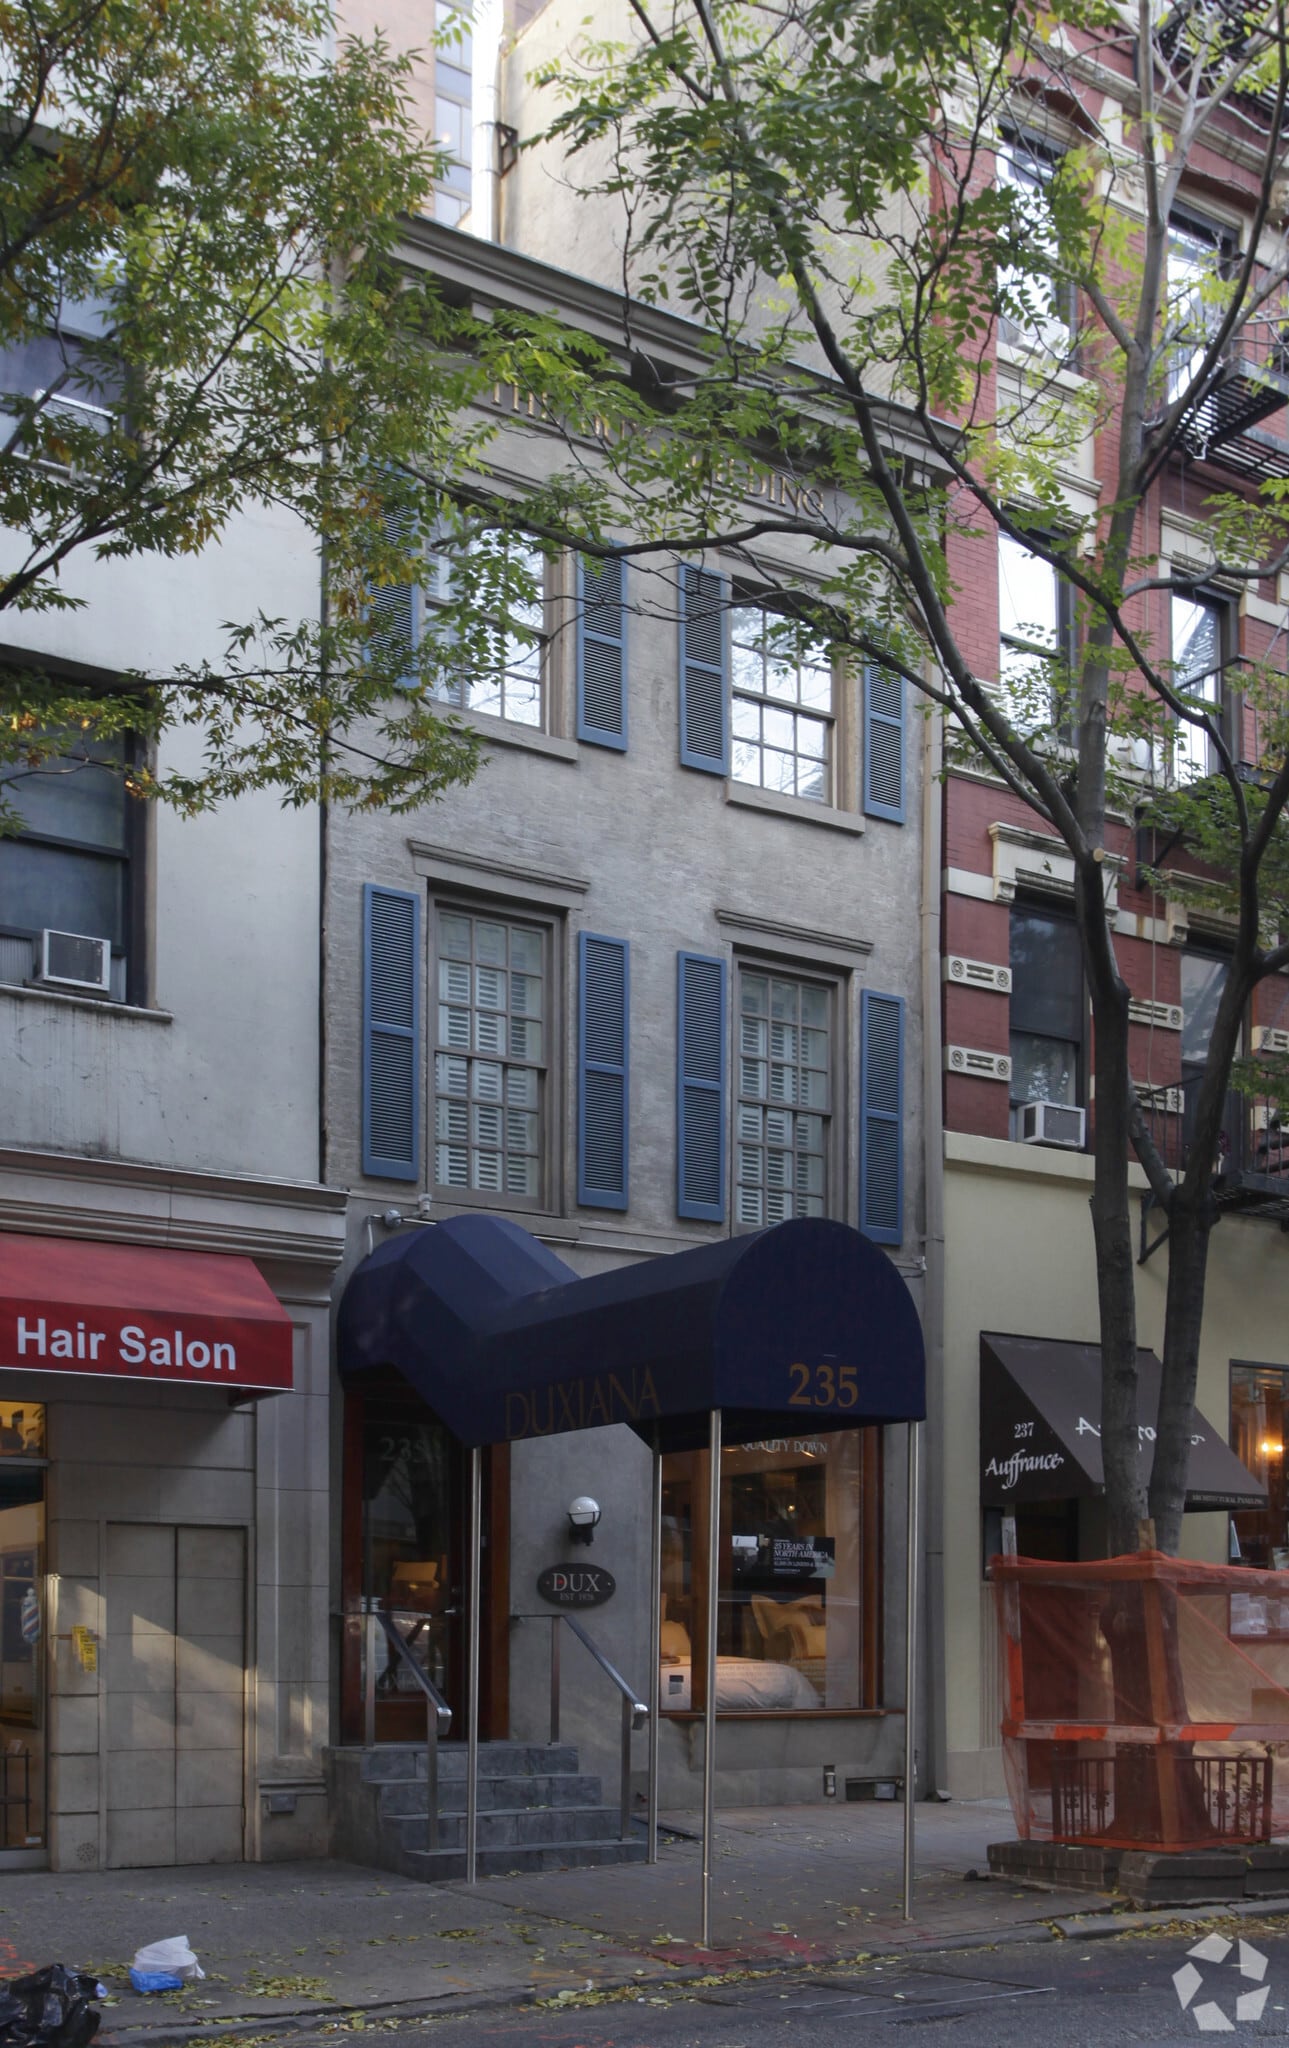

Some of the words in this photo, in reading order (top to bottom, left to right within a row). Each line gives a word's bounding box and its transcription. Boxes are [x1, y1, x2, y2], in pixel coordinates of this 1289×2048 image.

[16, 1316, 107, 1360] Hair
[118, 1325, 237, 1371] Salon
[787, 1362, 859, 1408] 235
[504, 1362, 663, 1441] DUXIANA
[1013, 1421, 1035, 1439] 237
[792, 1440, 829, 1454] DOWN
[984, 1447, 1065, 1490] Auffrance
[773, 1549, 798, 1558] NORTH
[782, 1542, 805, 1551] YEARS
[805, 1542, 815, 1551] IN
[551, 1572, 601, 1593] DUX
